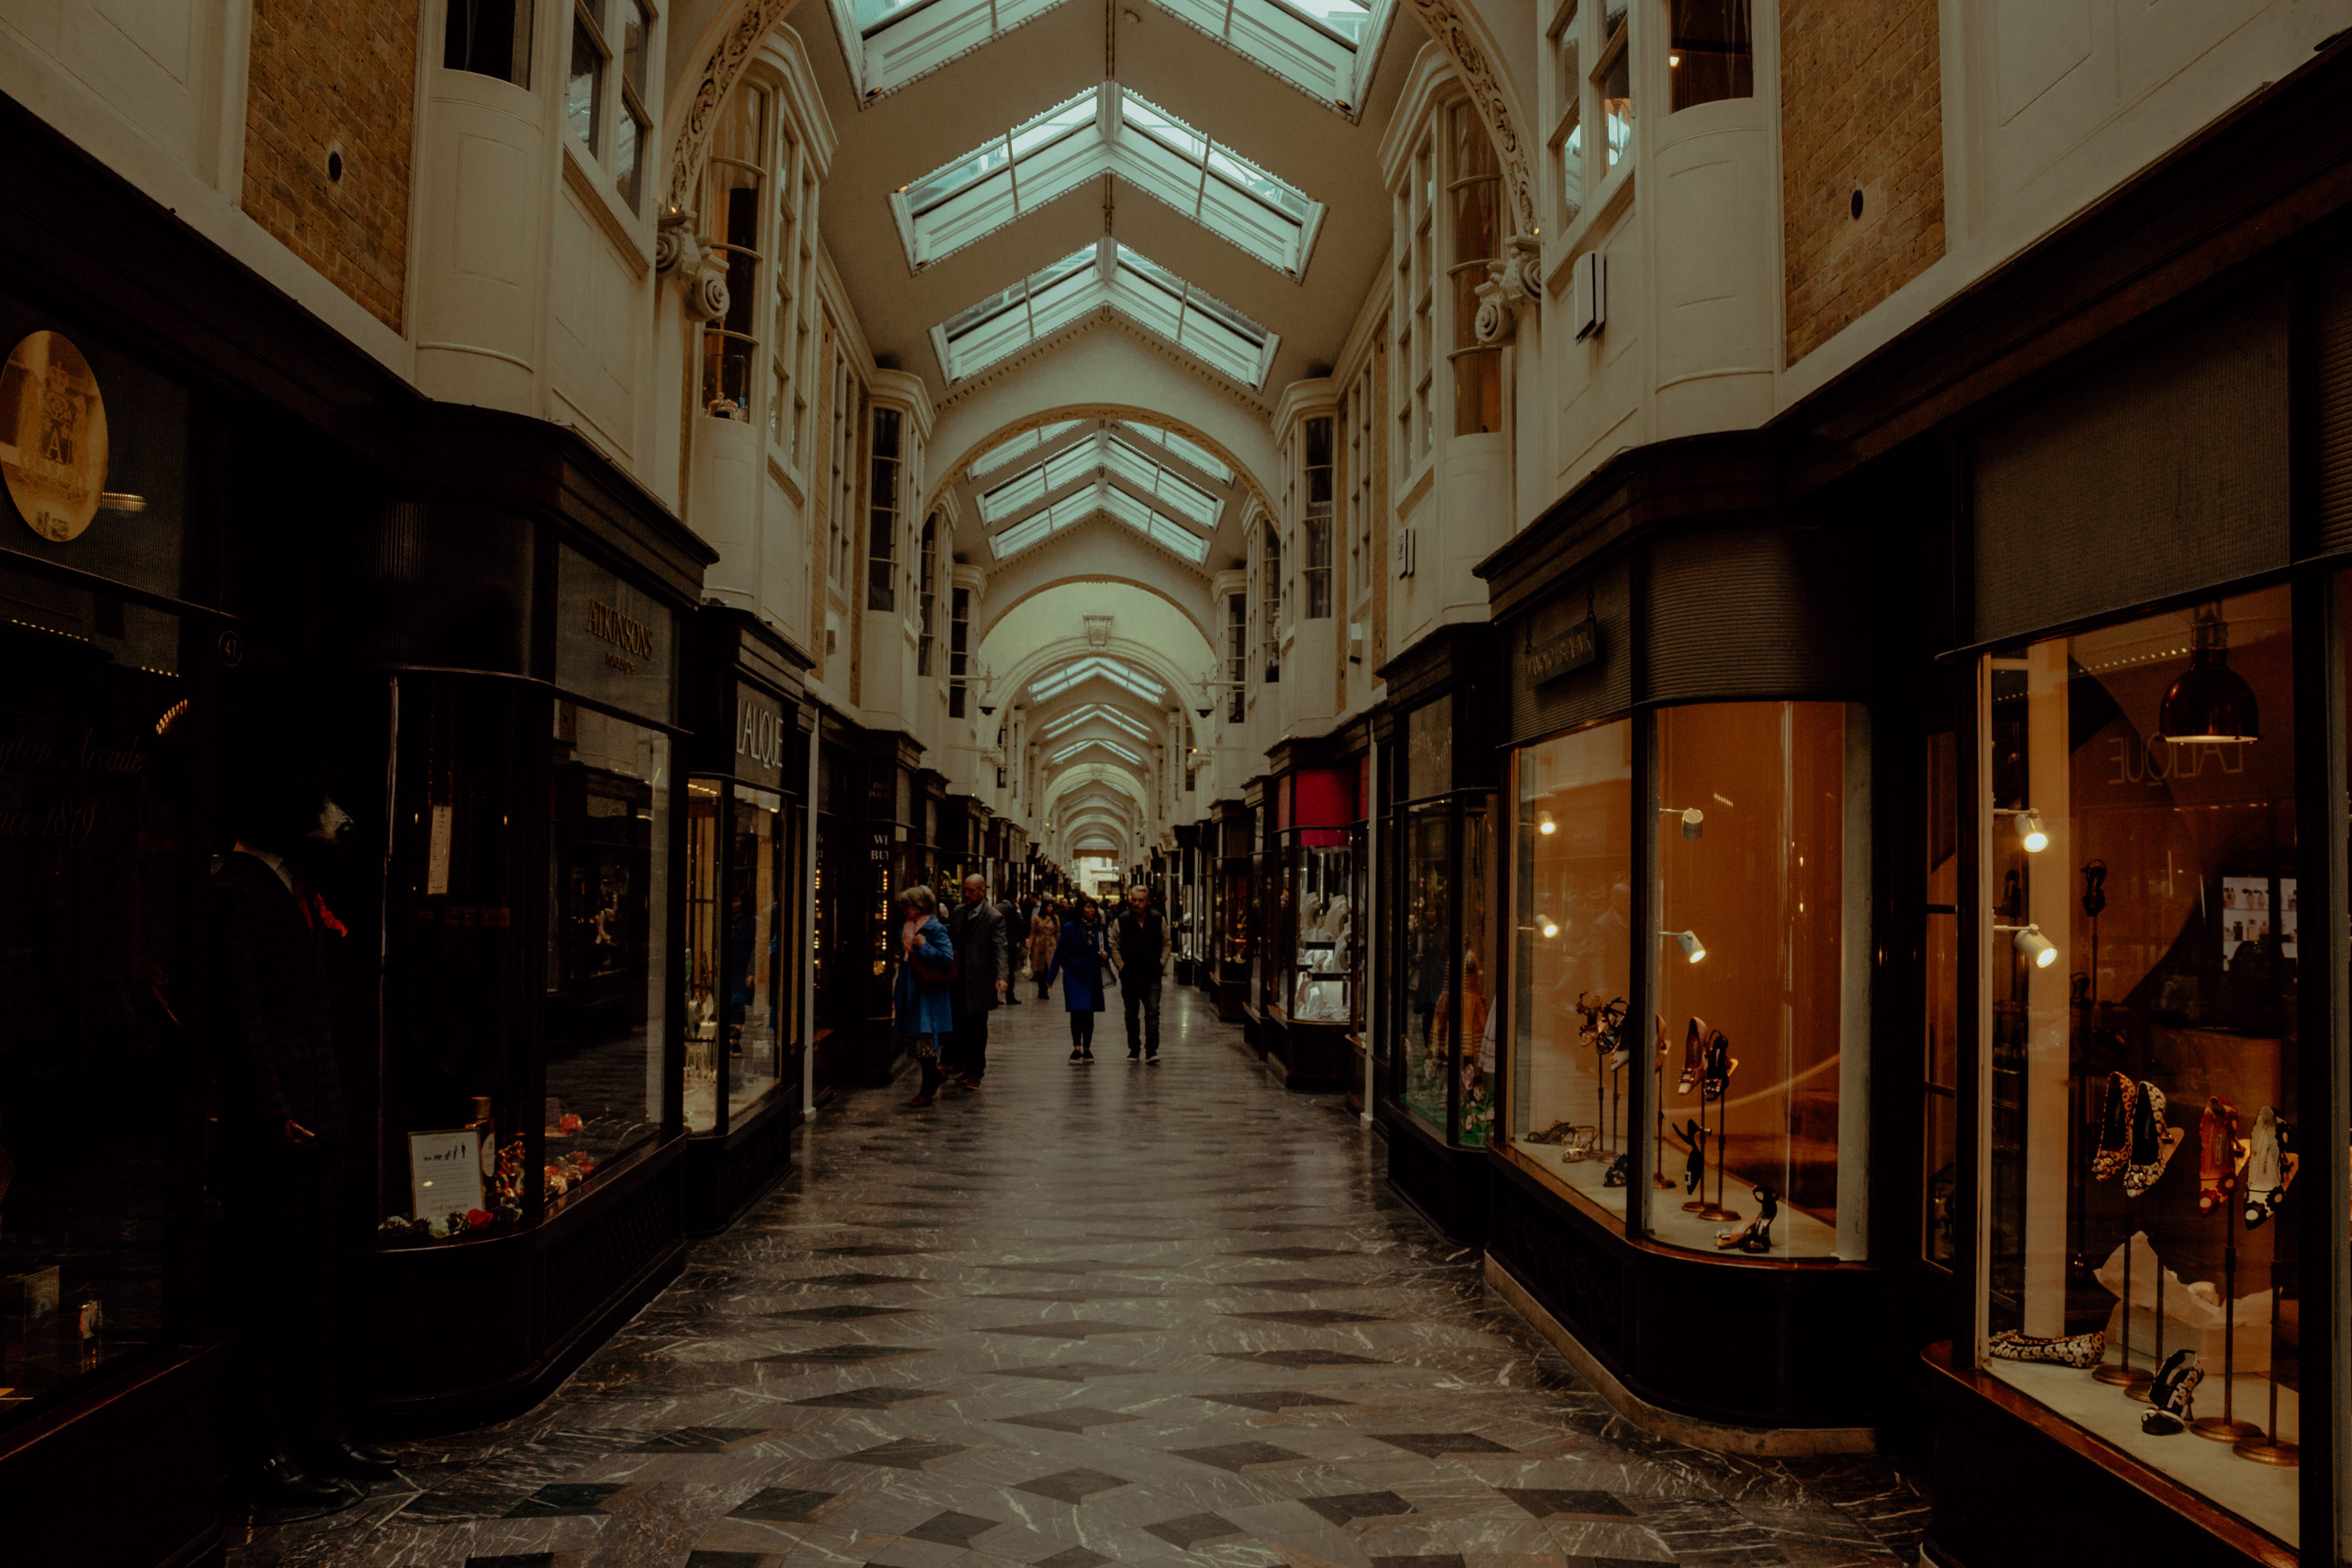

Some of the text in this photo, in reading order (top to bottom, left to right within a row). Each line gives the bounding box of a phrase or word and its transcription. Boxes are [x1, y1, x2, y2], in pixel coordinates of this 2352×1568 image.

[224, 638, 237, 657] 41
[586, 599, 653, 661] ATKINSONS
[737, 699, 783, 769] LALIQUE
